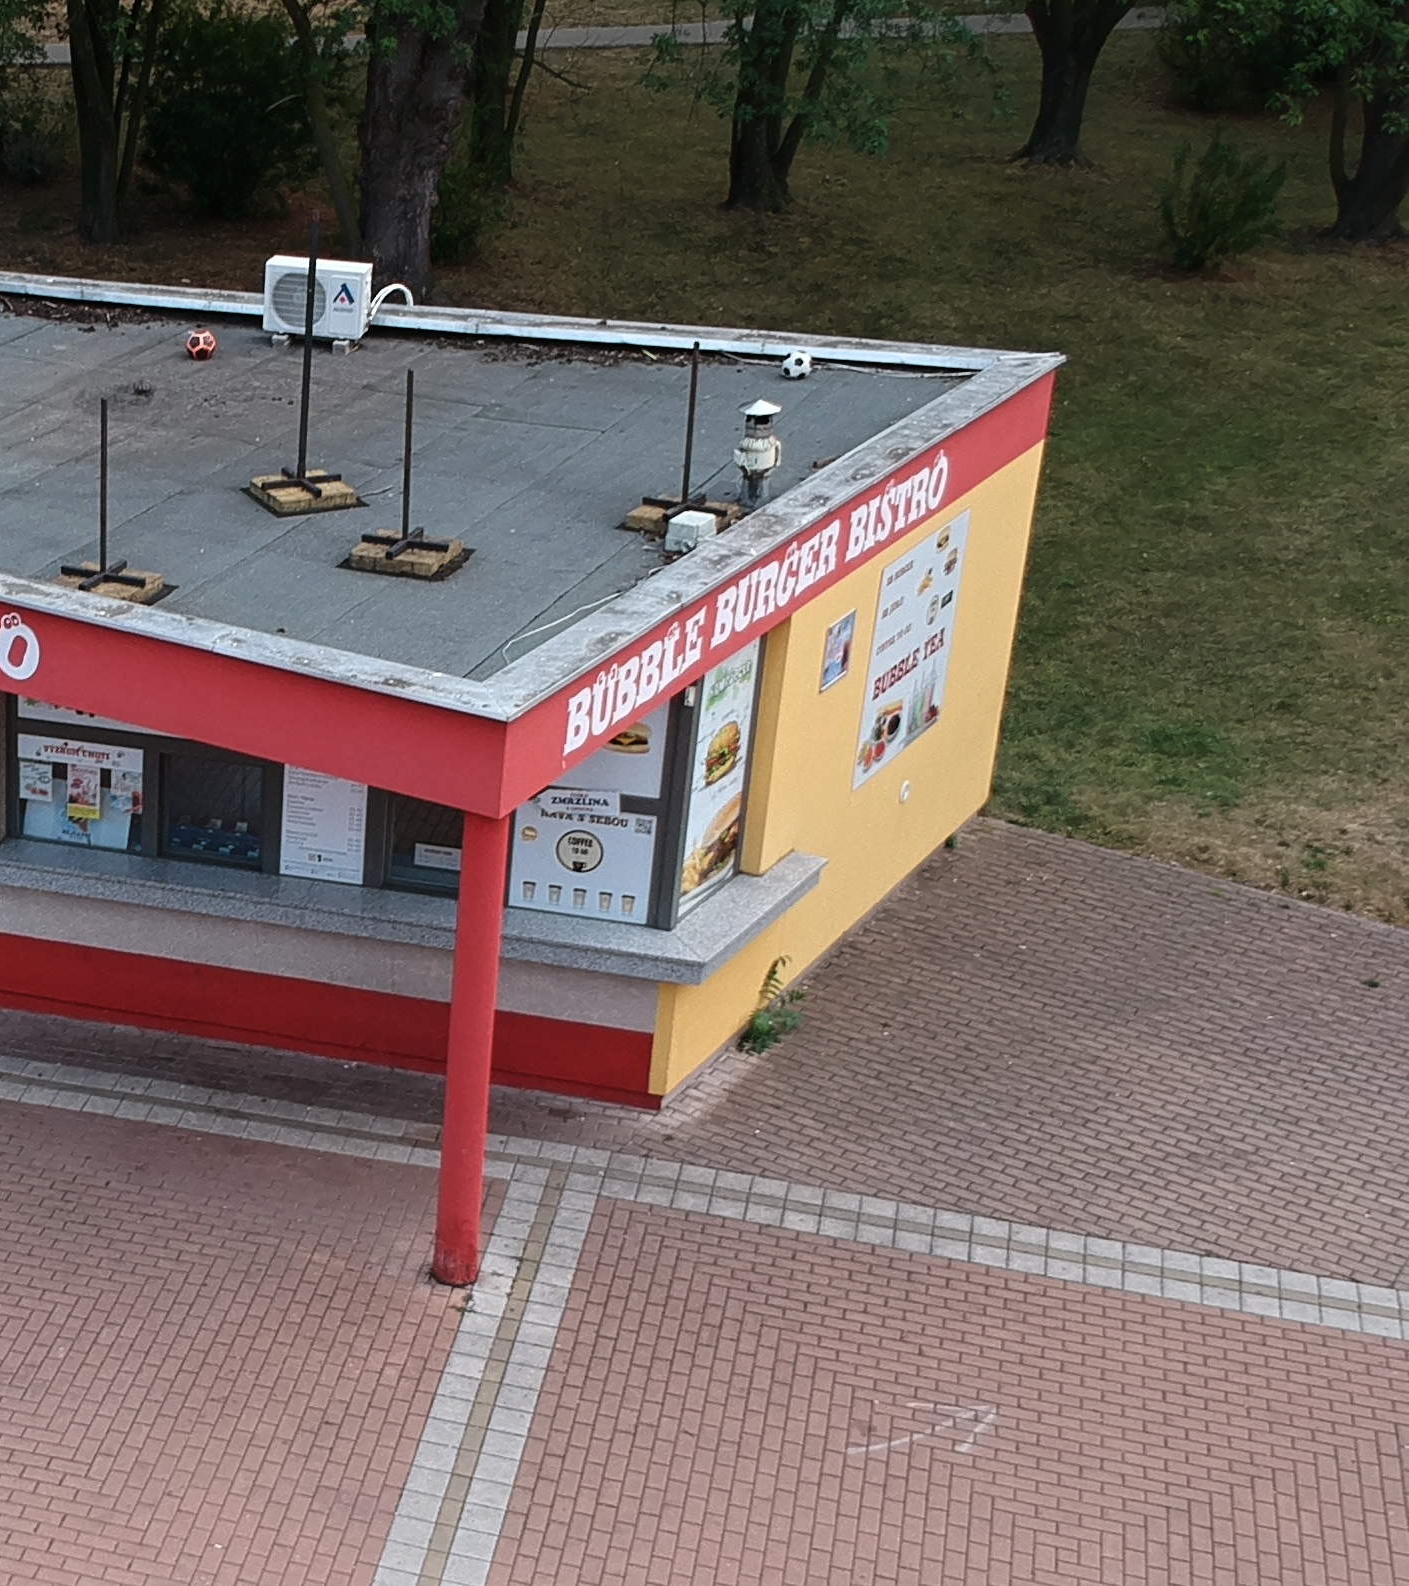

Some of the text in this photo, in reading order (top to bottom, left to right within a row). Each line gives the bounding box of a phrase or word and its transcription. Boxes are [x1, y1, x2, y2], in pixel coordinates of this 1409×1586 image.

[562, 450, 949, 757] BUBBLE BURGER BISTRO
[872, 627, 945, 701] BUBBLE TEA
[568, 836, 593, 848] COFFEE
